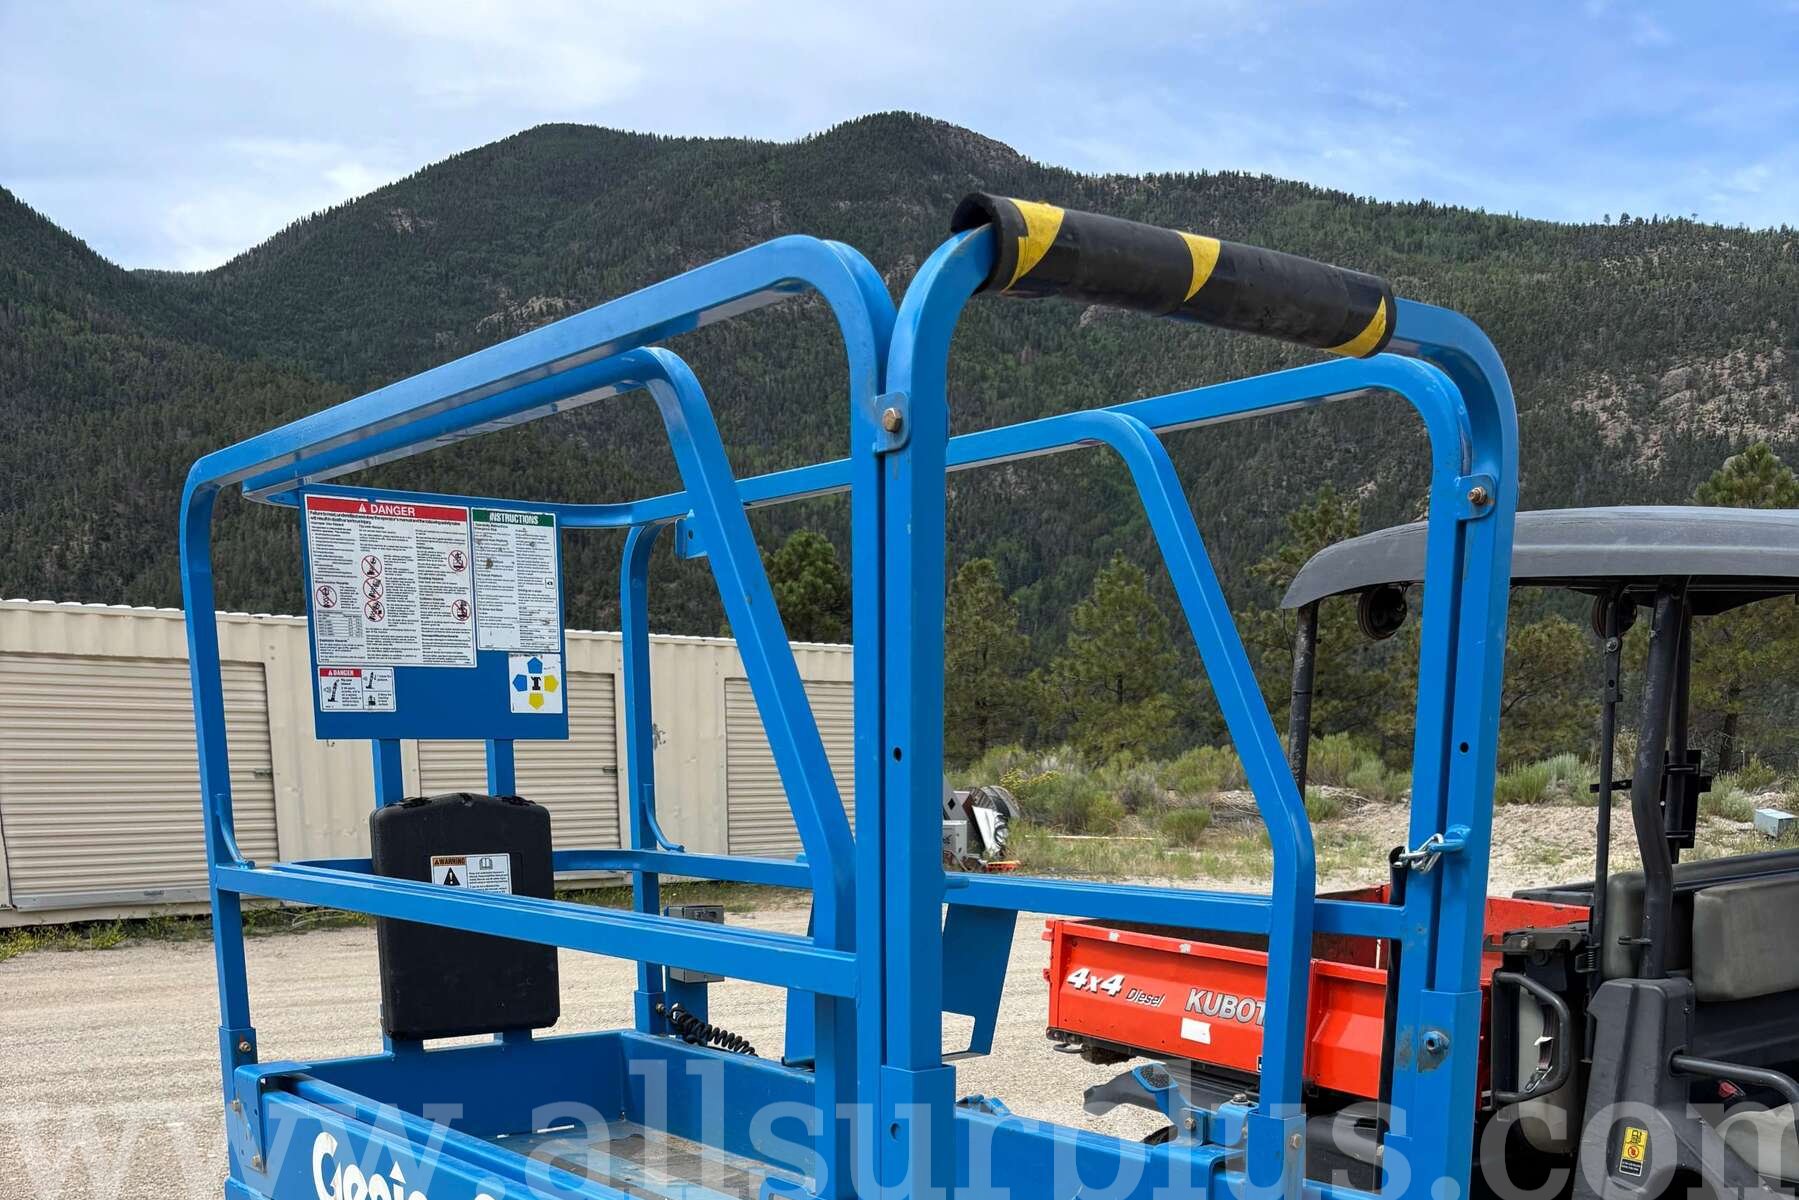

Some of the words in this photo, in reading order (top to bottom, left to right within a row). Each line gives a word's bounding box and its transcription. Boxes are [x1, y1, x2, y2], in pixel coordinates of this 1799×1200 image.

[370, 504, 415, 517] DANGER
[489, 512, 539, 525] INSTRUCTIONS
[1066, 966, 1126, 997] 4x4
[1126, 987, 1165, 1007] Diesel
